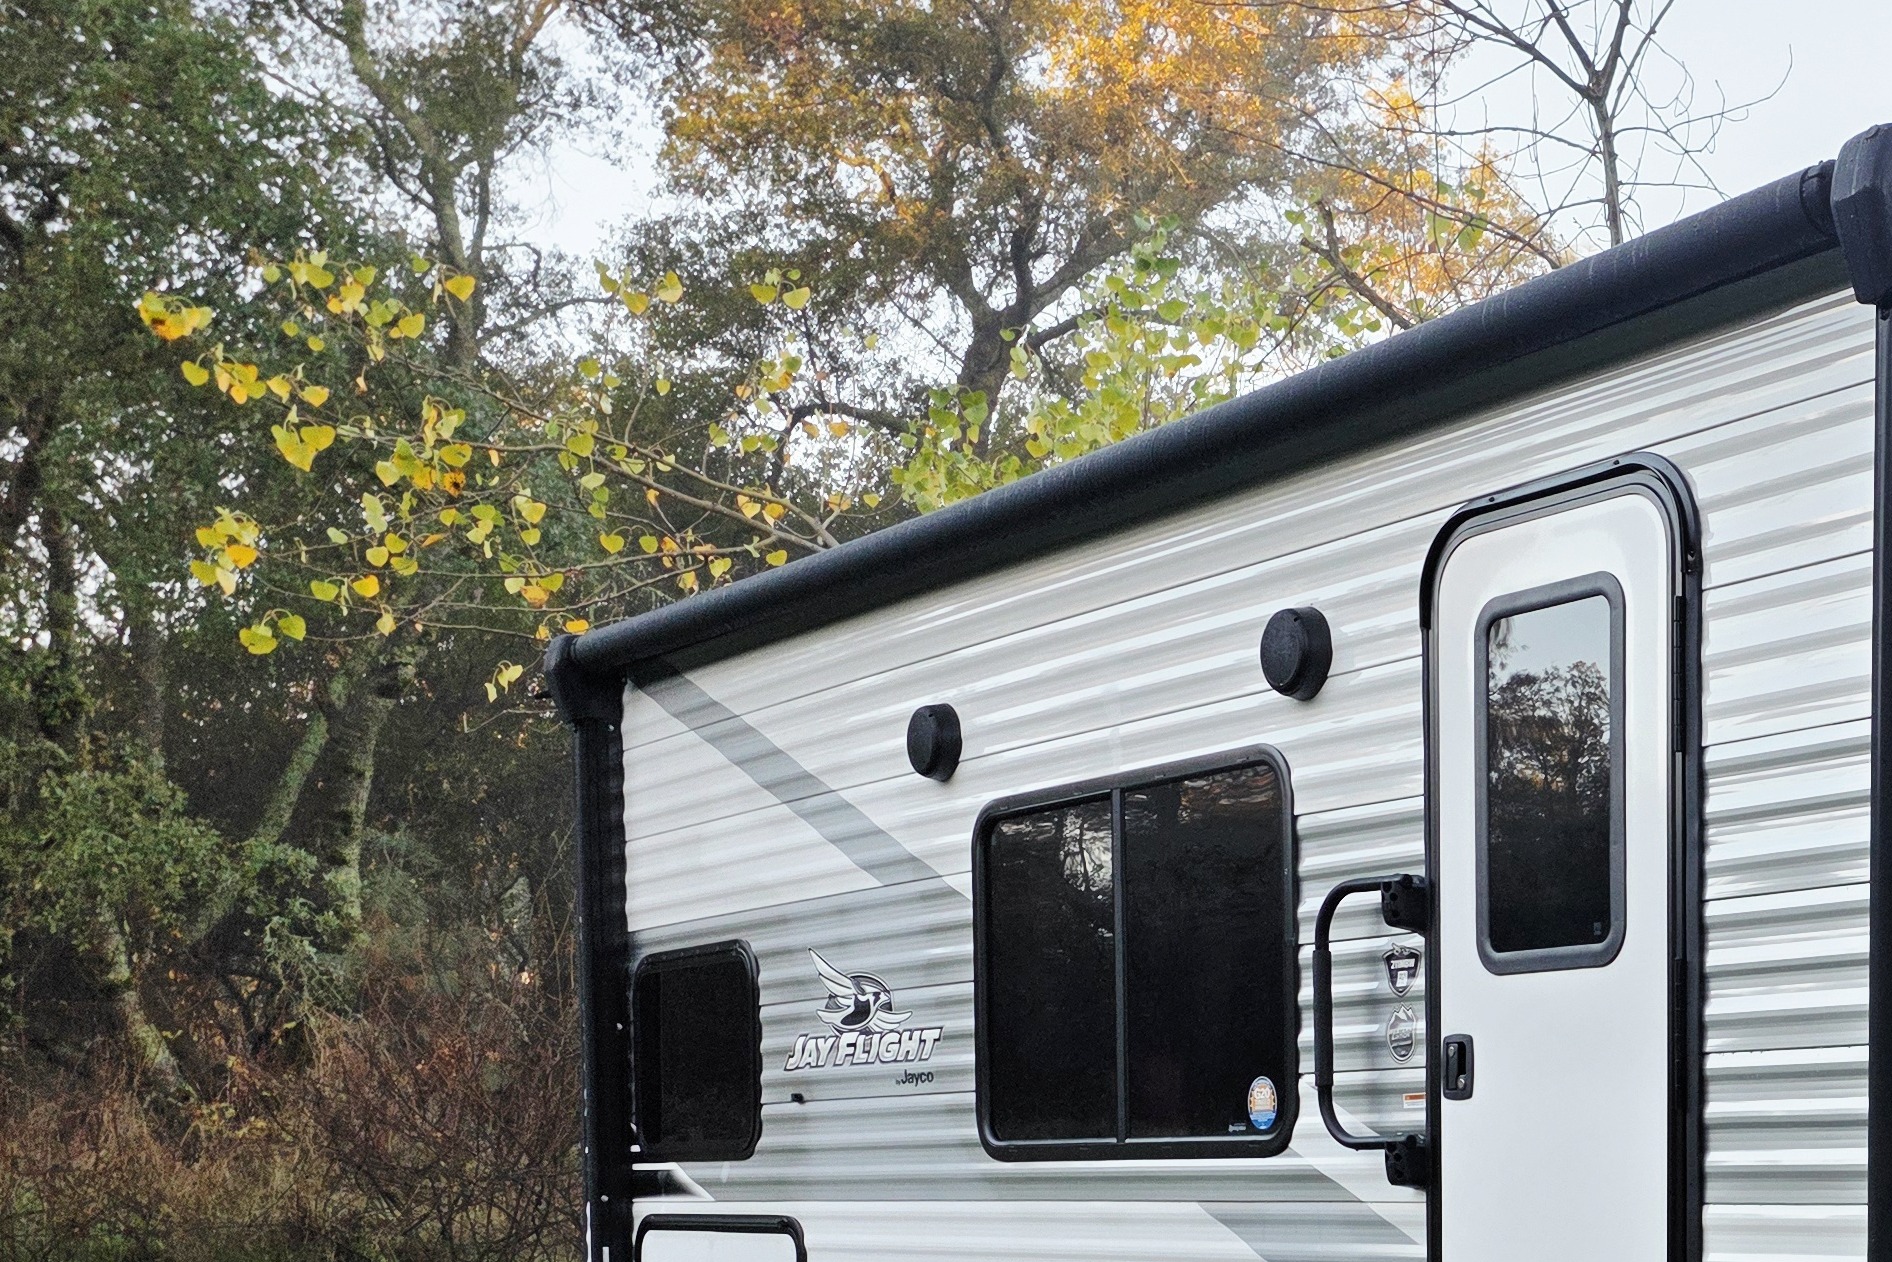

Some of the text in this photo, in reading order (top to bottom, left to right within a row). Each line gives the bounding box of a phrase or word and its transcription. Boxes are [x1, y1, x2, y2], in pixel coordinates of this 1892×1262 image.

[785, 1027, 943, 1071] JAY FLIGHT
[901, 1068, 934, 1087] Jayco
